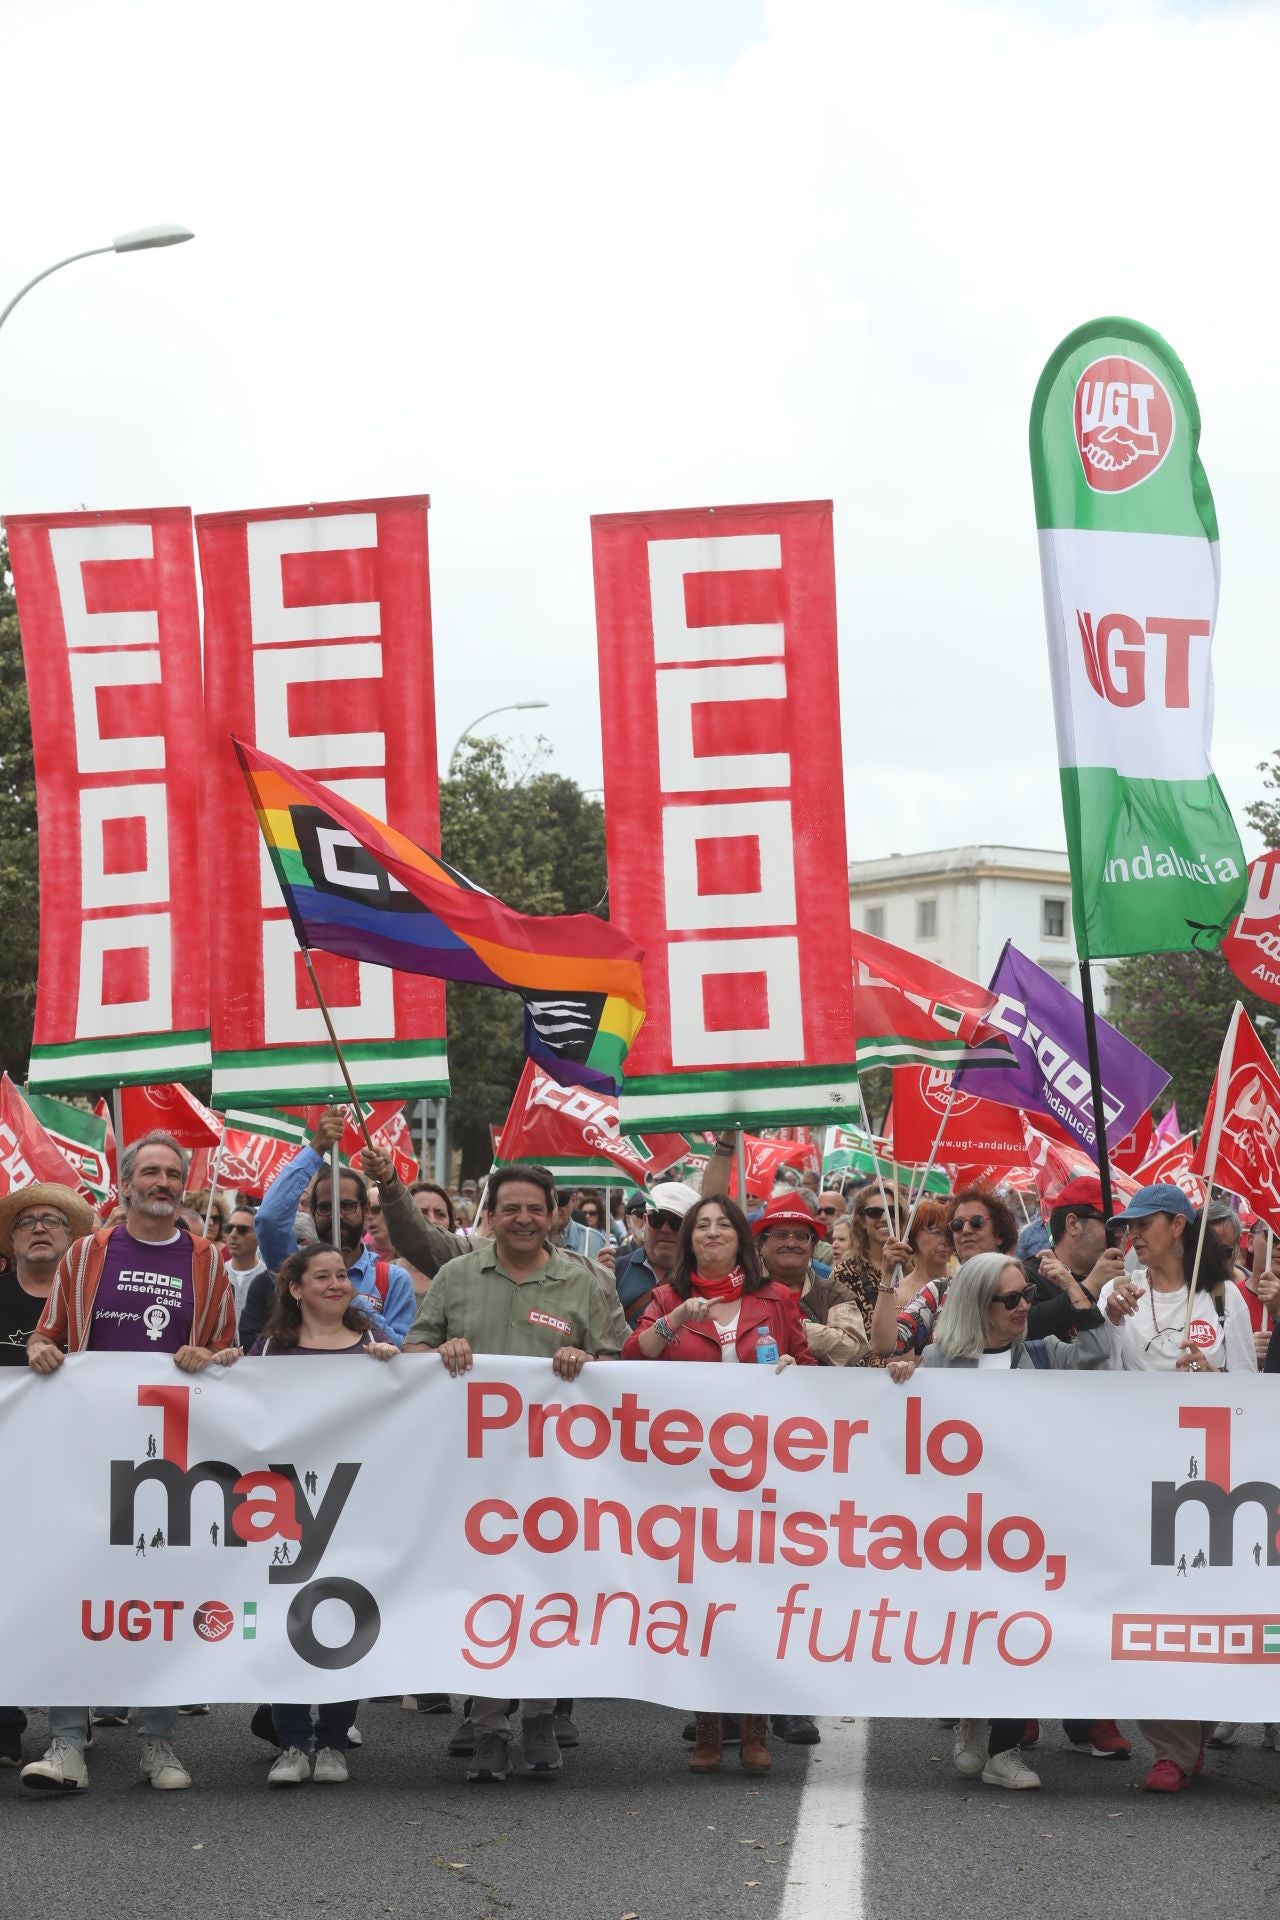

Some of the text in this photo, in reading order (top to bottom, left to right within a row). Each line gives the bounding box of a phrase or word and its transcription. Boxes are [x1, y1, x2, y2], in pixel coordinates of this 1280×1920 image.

[1082, 379, 1155, 434] UGT
[48, 523, 173, 1040] CCOO
[647, 533, 805, 1067] CCOO
[1042, 1081, 1096, 1146] Andalucía
[582, 1124, 641, 1163] Cádiz
[117, 1283, 182, 1299] enseñanza
[119, 1270, 170, 1287] CCOO
[95, 1308, 142, 1327] siempre
[155, 1296, 182, 1308] Cádiz
[1189, 1324, 1212, 1337] UGT
[467, 1381, 984, 1492] Proteger lo
[464, 1487, 1067, 1592] conquistado,
[81, 1600, 184, 1642] UGT
[460, 1582, 1053, 1670] ganar futuro
[1121, 1623, 1253, 1655] CCOO
